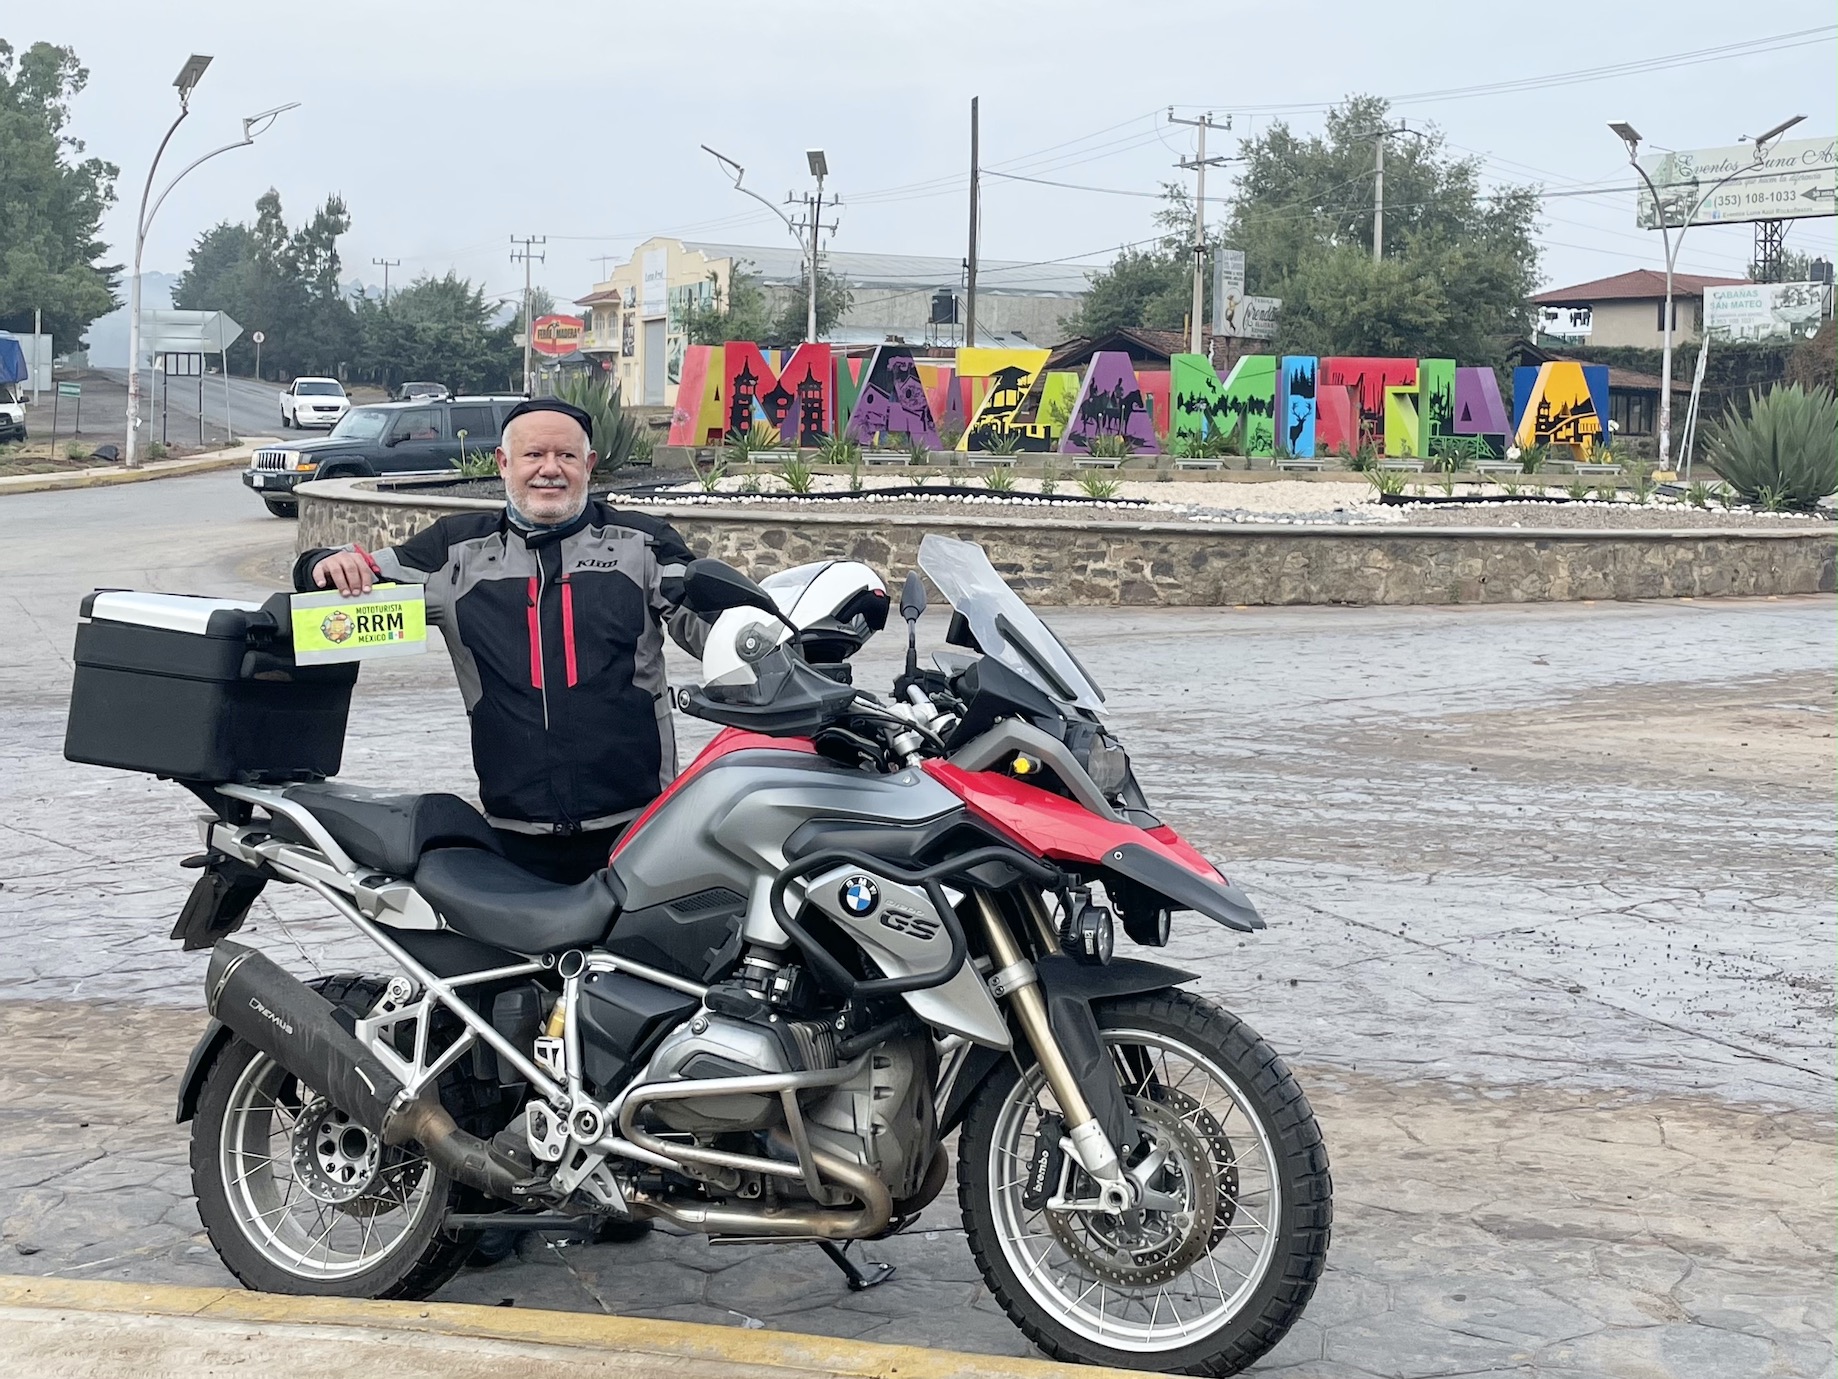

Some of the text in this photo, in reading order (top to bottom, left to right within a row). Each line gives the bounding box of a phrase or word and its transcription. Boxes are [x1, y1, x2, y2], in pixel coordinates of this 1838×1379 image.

[1675, 154, 1738, 177] Eventos
[1714, 190, 1796, 209] (353) 108-1033
[1710, 299, 1763, 310] SAN MATEO
[356, 603, 403, 615] MOTOTURISTA
[356, 612, 404, 634] RRM
[845, 877, 878, 896] BMW
[880, 909, 940, 940] GS
[1032, 1150, 1050, 1193] brembo
